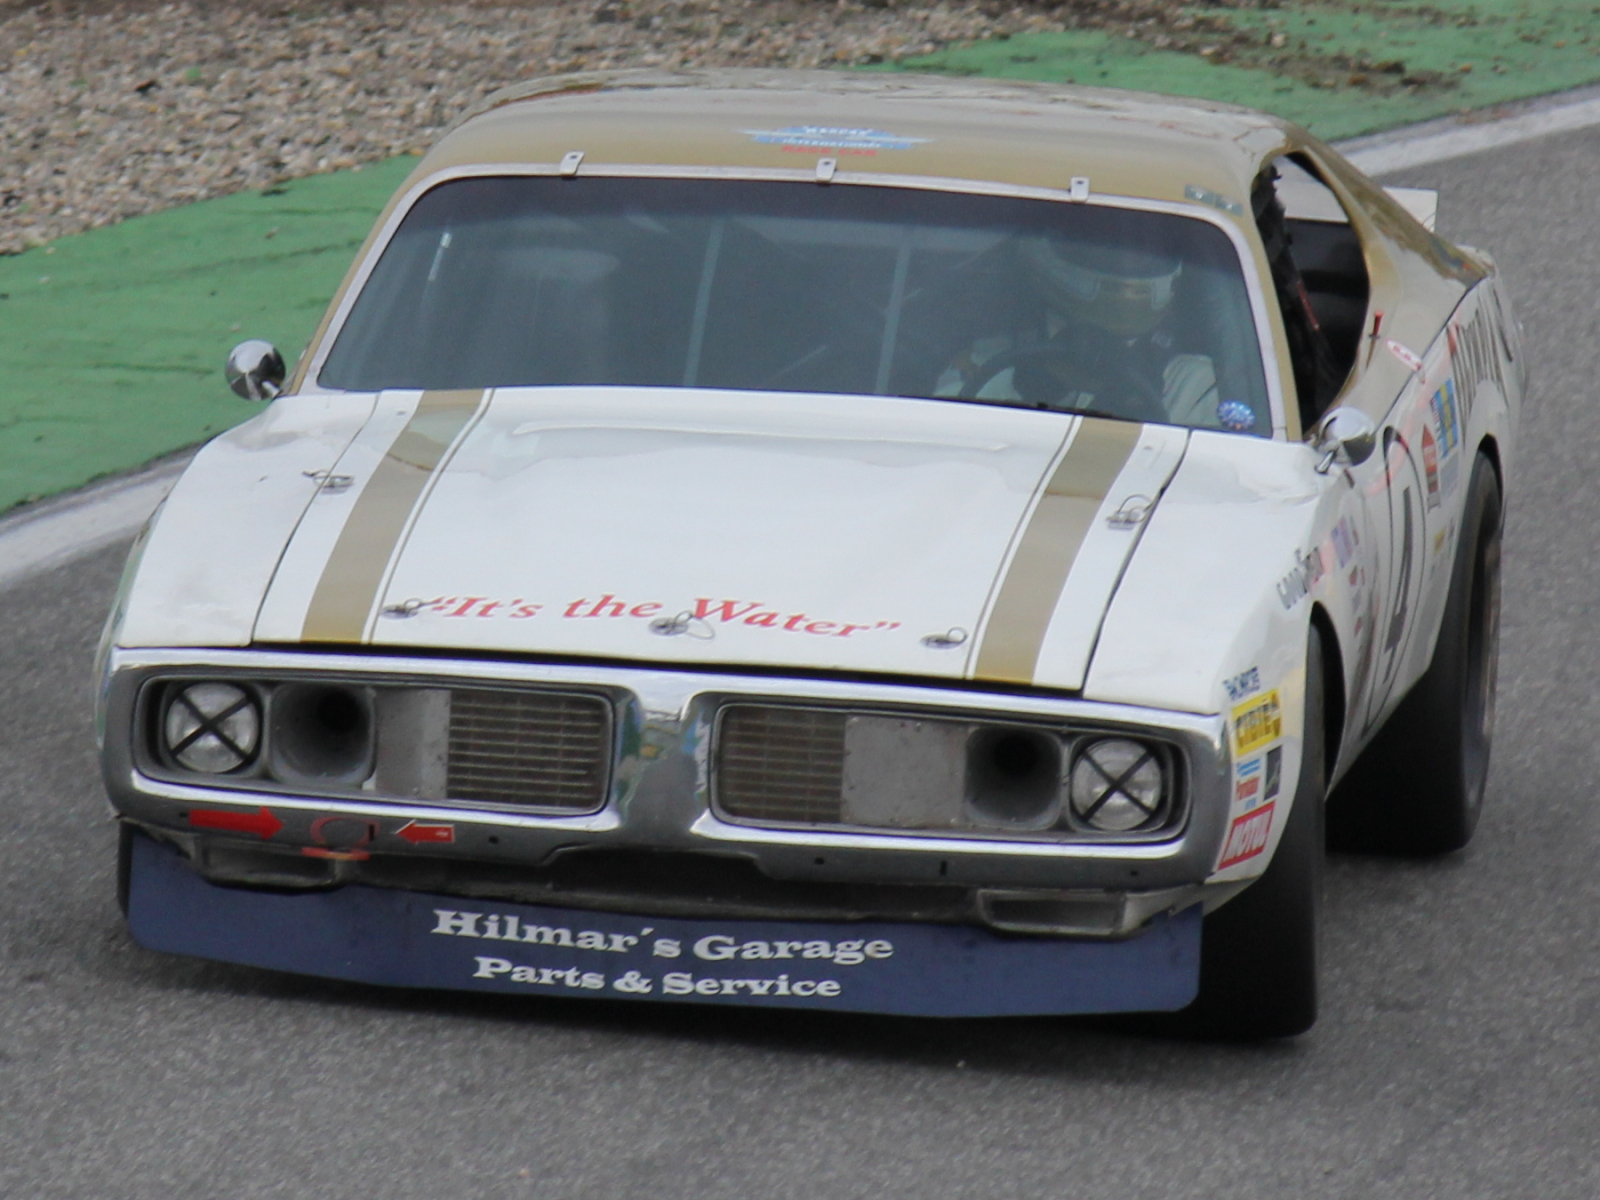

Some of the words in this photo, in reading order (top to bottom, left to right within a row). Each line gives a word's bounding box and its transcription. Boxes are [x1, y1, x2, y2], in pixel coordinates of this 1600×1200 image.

[563, 594, 662, 619] the
[693, 935, 894, 965] Garage
[473, 956, 605, 990] Parts
[612, 970, 653, 994] &
[663, 972, 842, 997] Service
